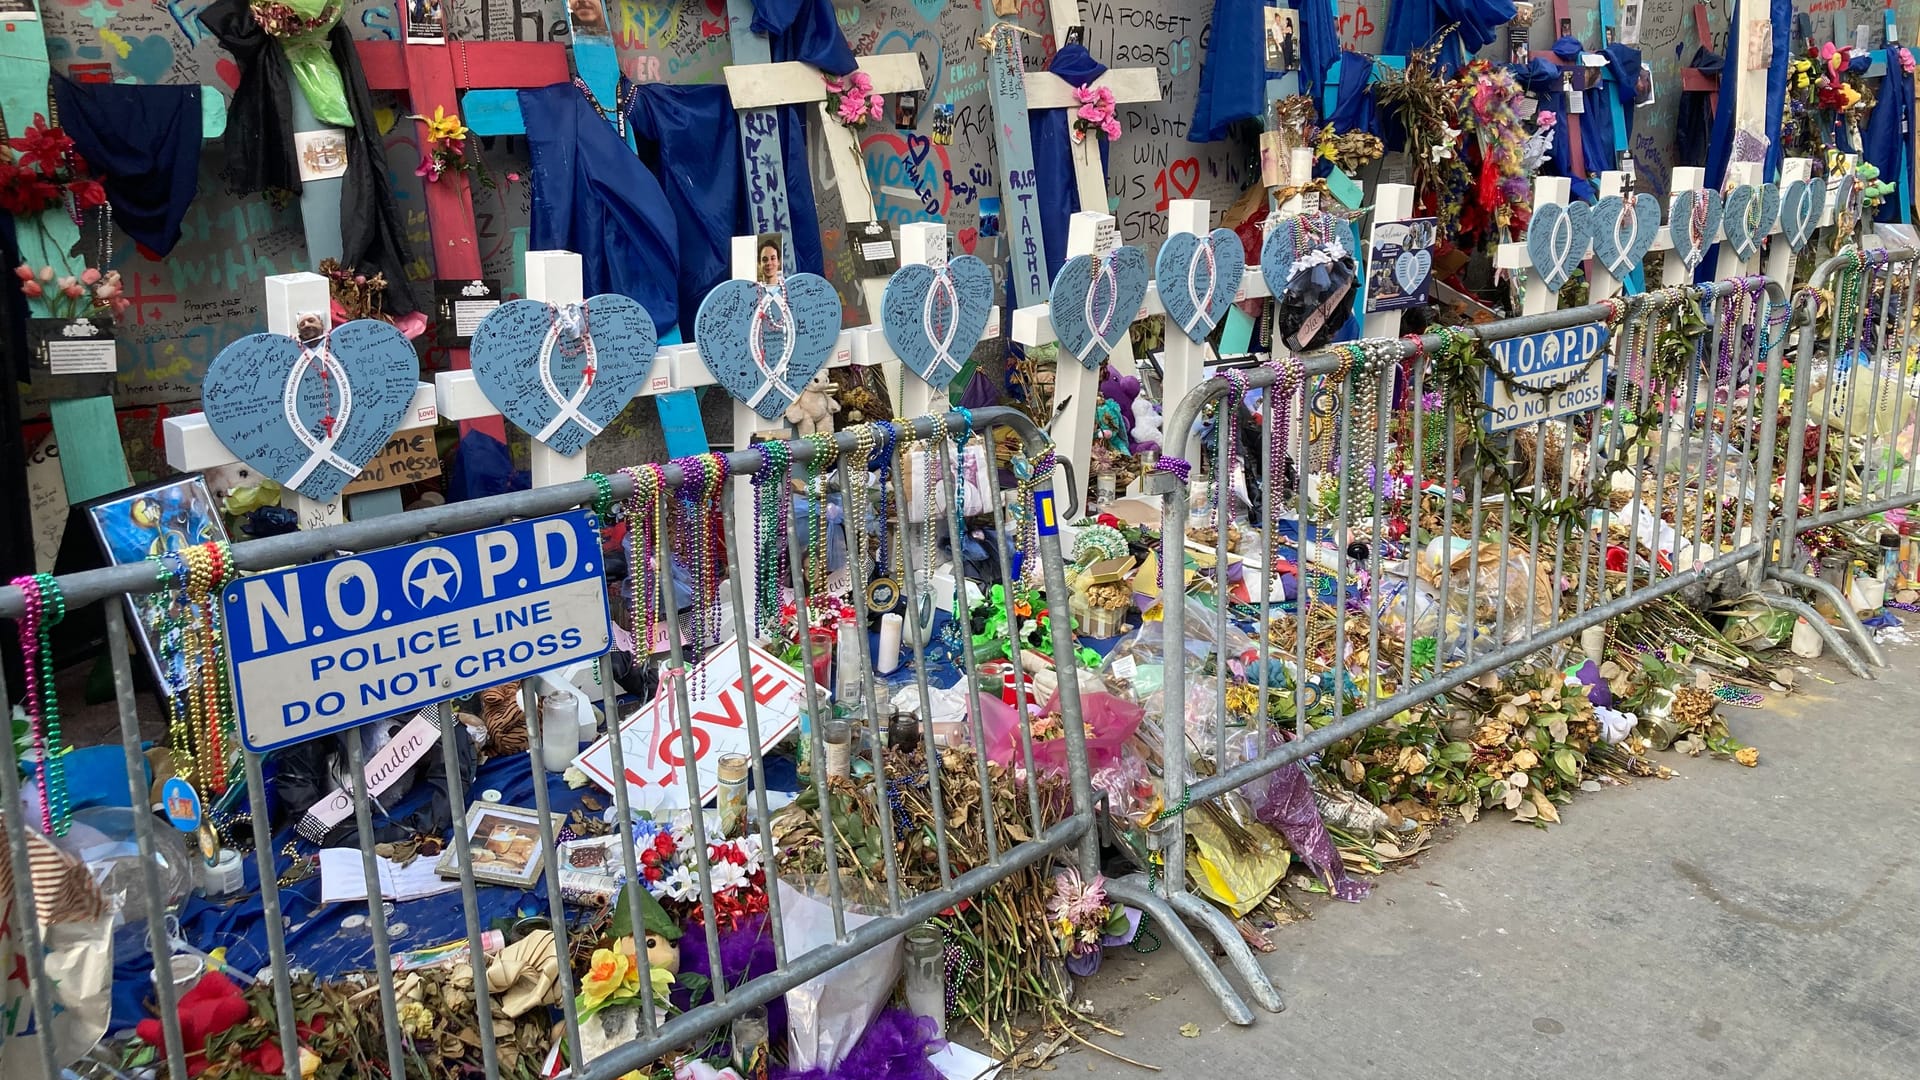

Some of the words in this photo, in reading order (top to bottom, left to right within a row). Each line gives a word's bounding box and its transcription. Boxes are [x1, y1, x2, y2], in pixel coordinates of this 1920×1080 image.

[1118, 8, 1191, 36] FORGET
[744, 112, 778, 137] RIP
[902, 154, 940, 216] KHALED
[125, 383, 153, 394] home
[158, 384, 170, 393] of
[173, 384, 193, 394] the
[309, 401, 329, 409] Taylo
[1495, 404, 1519, 425] DO
[1524, 395, 1553, 418] NO
[1557, 385, 1600, 409] CROSS
[419, 410, 435, 418] LOVE
[243, 559, 394, 654] N.O.
[475, 518, 595, 600] P.D.
[310, 622, 462, 681] POLICE
[472, 600, 555, 637] LINE
[281, 690, 346, 729] DO
[359, 663, 446, 707] NOT
[454, 626, 583, 680] CROSS
